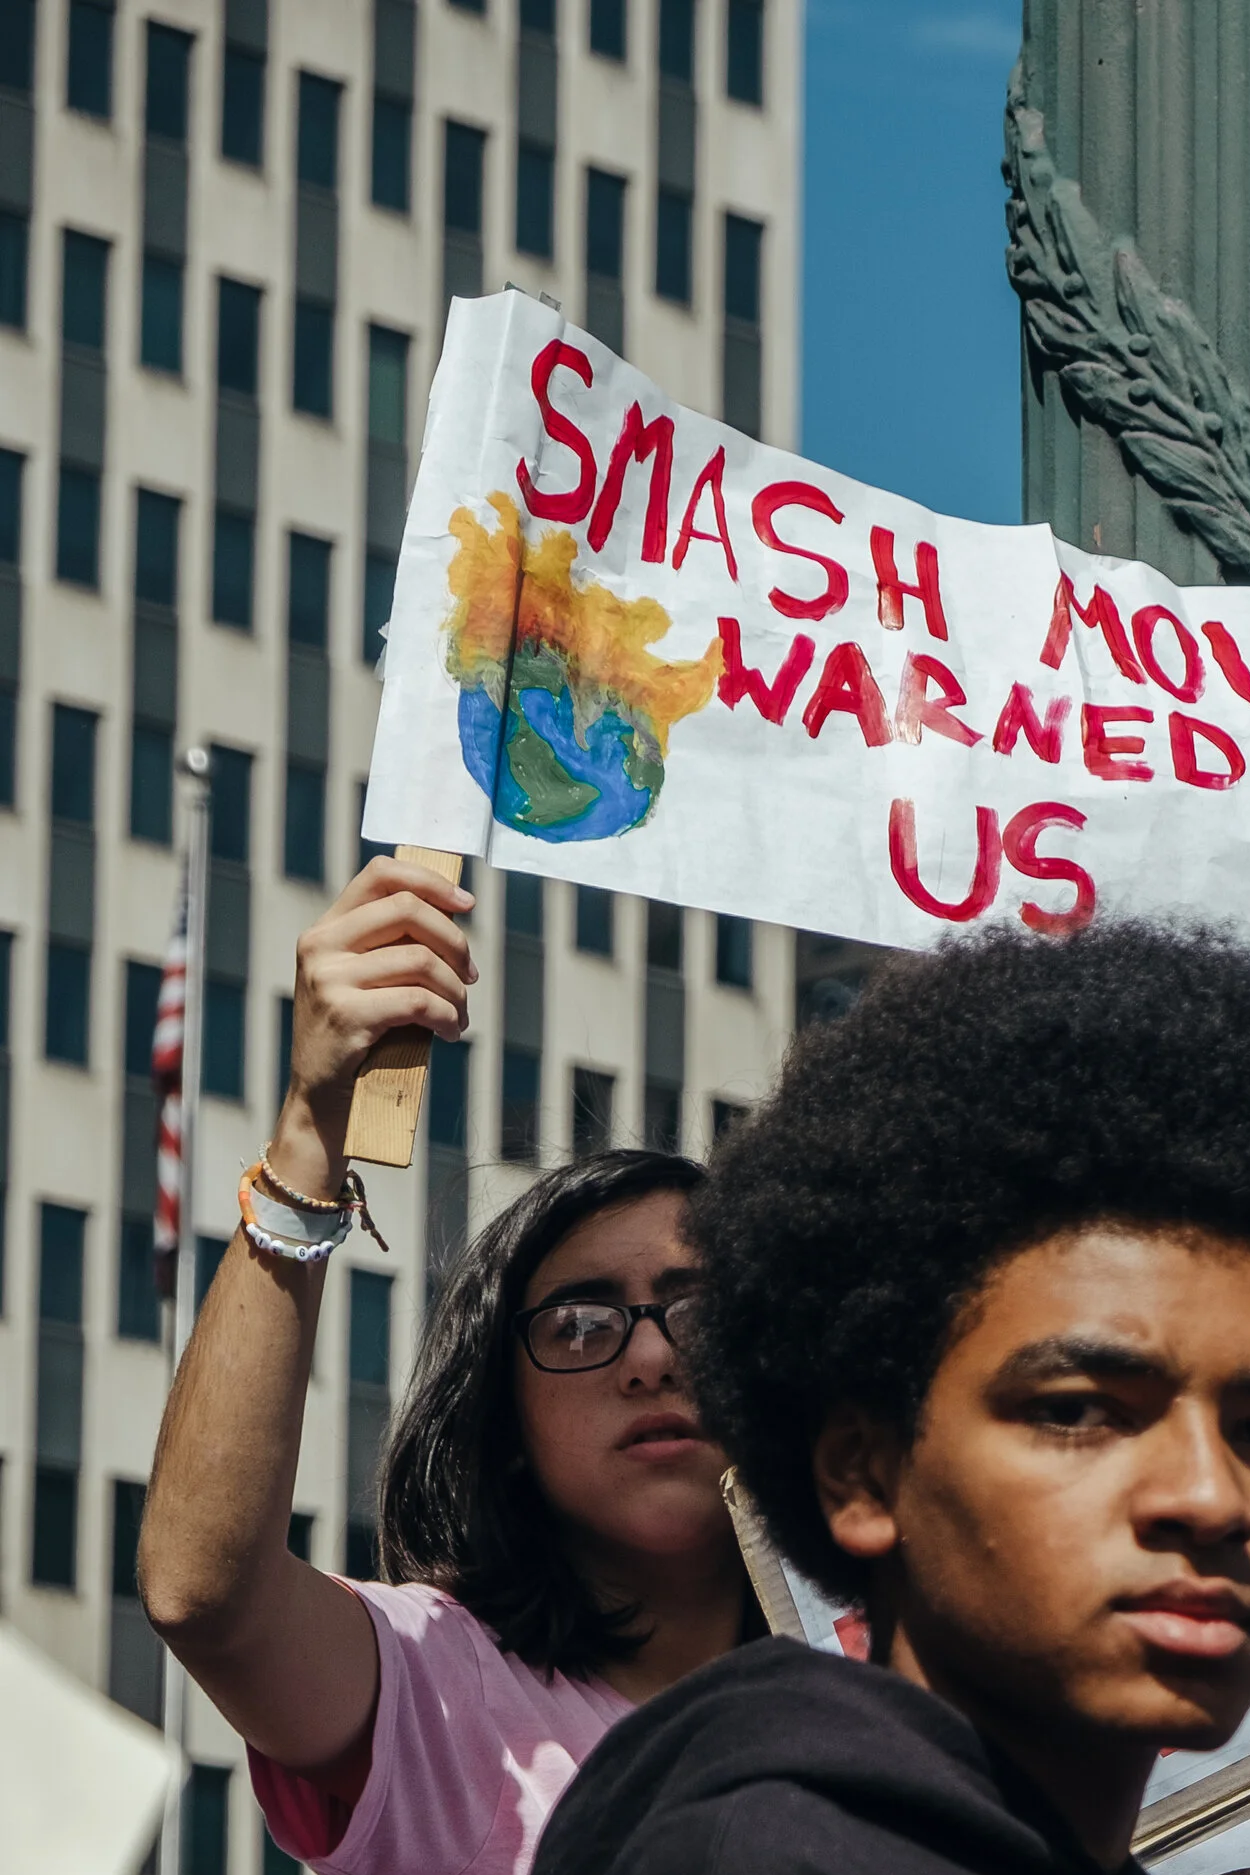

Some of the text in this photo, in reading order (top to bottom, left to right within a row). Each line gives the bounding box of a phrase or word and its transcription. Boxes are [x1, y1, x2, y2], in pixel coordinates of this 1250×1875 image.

[515, 338, 949, 642] SMASH
[716, 616, 1248, 791] WARNED
[887, 797, 1097, 936] US
